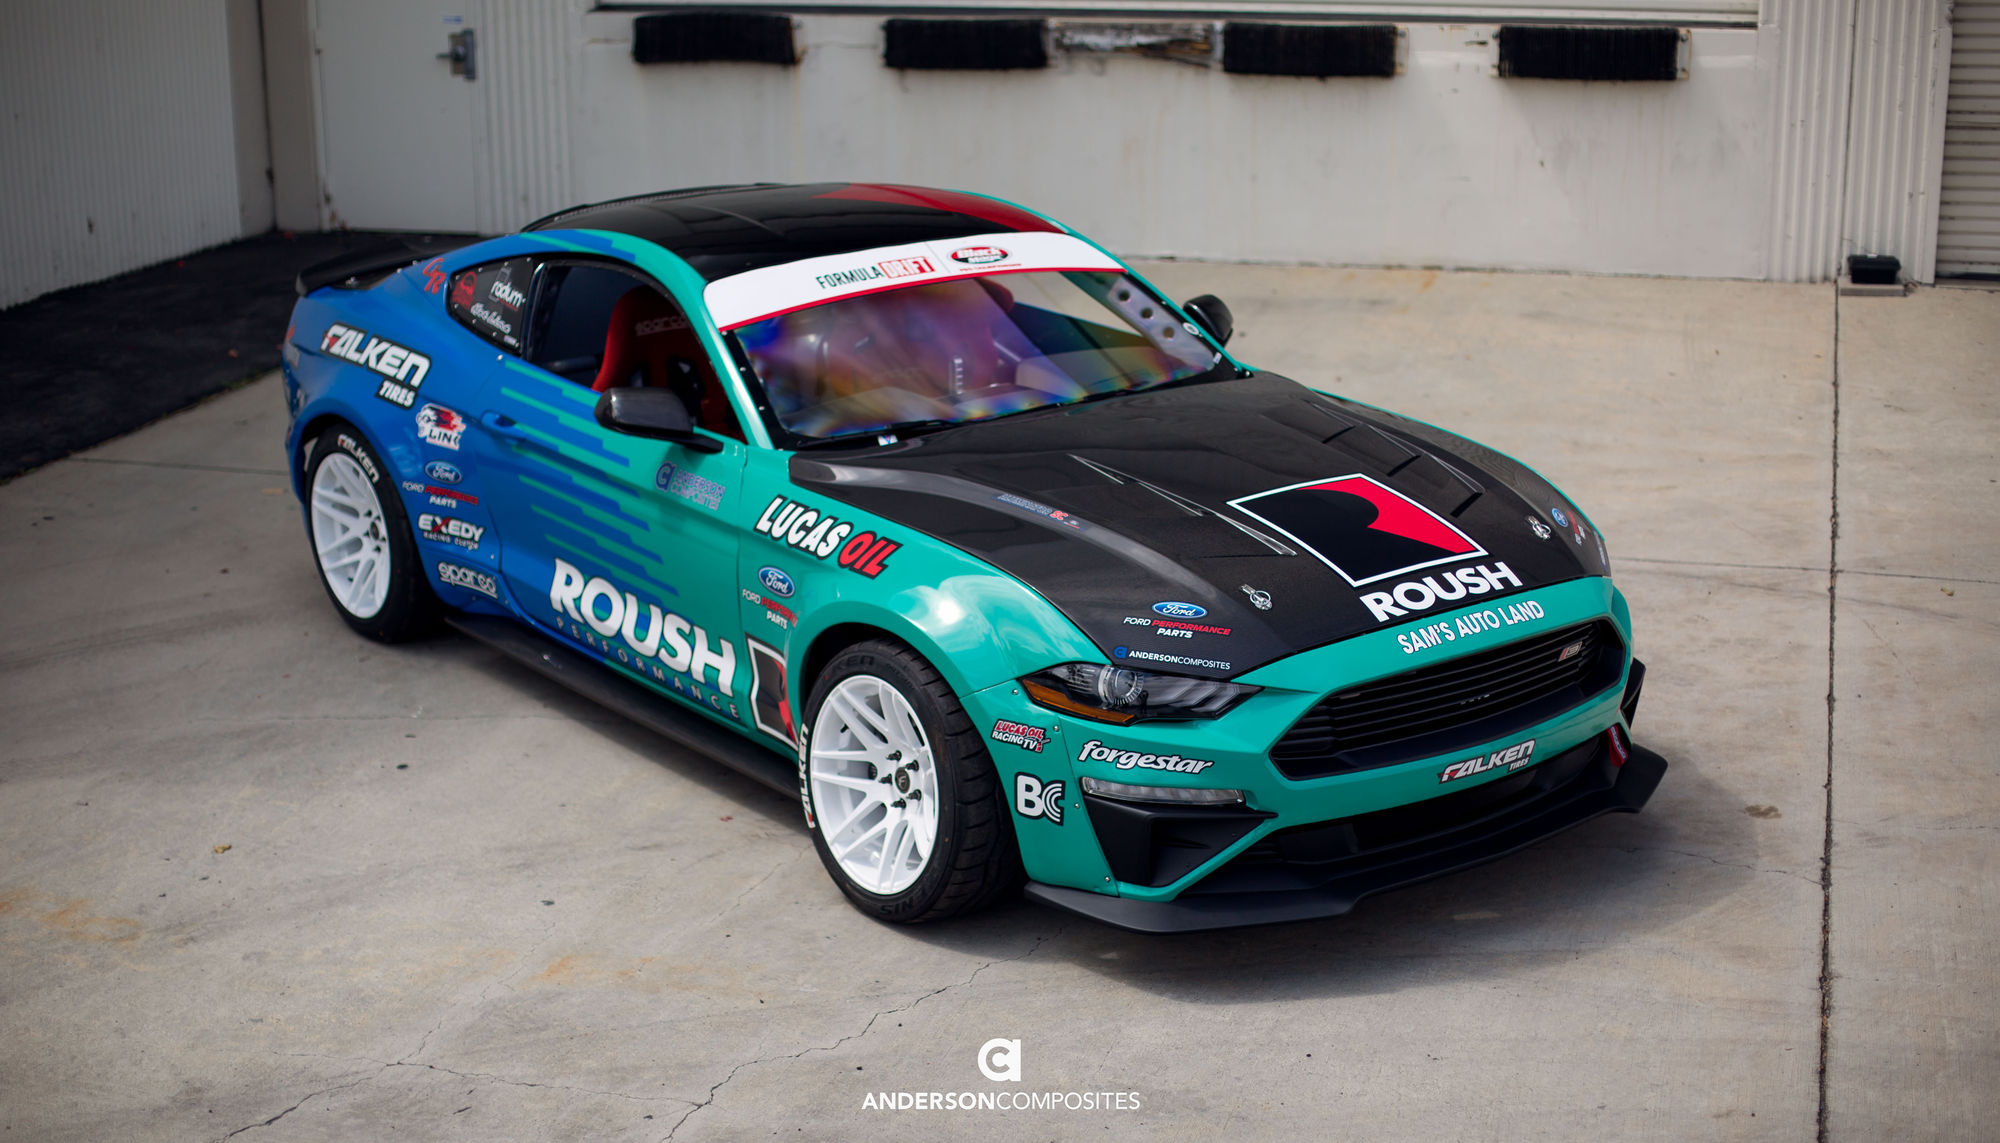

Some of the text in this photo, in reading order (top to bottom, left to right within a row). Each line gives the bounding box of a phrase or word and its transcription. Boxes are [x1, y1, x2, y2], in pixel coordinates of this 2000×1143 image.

[815, 256, 935, 289] FORMULA DRIFT
[320, 323, 431, 388] FALKEN
[379, 380, 415, 407] TIRES
[337, 433, 380, 484] FALKEN
[432, 463, 456, 481] Ford
[402, 481, 424, 494] FORD
[429, 495, 457, 509] PARTS
[418, 513, 484, 542] EXEDY
[423, 531, 451, 543] RACING
[754, 495, 902, 578] LUCAS OIL
[438, 562, 497, 598] sparco
[765, 570, 789, 594] Ford
[1359, 561, 1523, 623] ROUSH
[742, 588, 761, 604] FORD
[1162, 603, 1196, 617] Ford
[550, 557, 736, 698] ROUSH
[766, 610, 787, 630] PARTS
[1123, 617, 1232, 636] FORD PERFORMANCE
[1156, 628, 1194, 639] PARTS
[1397, 600, 1545, 655] SAM'S AUTO LAND
[556, 615, 740, 719] PERFORMANCE
[995, 720, 1044, 740] LUCAS OIL
[1078, 740, 1214, 774] forgestar
[1438, 739, 1536, 783] FALKEN
[1508, 756, 1530, 772] TIRES
[798, 722, 816, 829] FALKEN
[1016, 775, 1063, 823] BC
